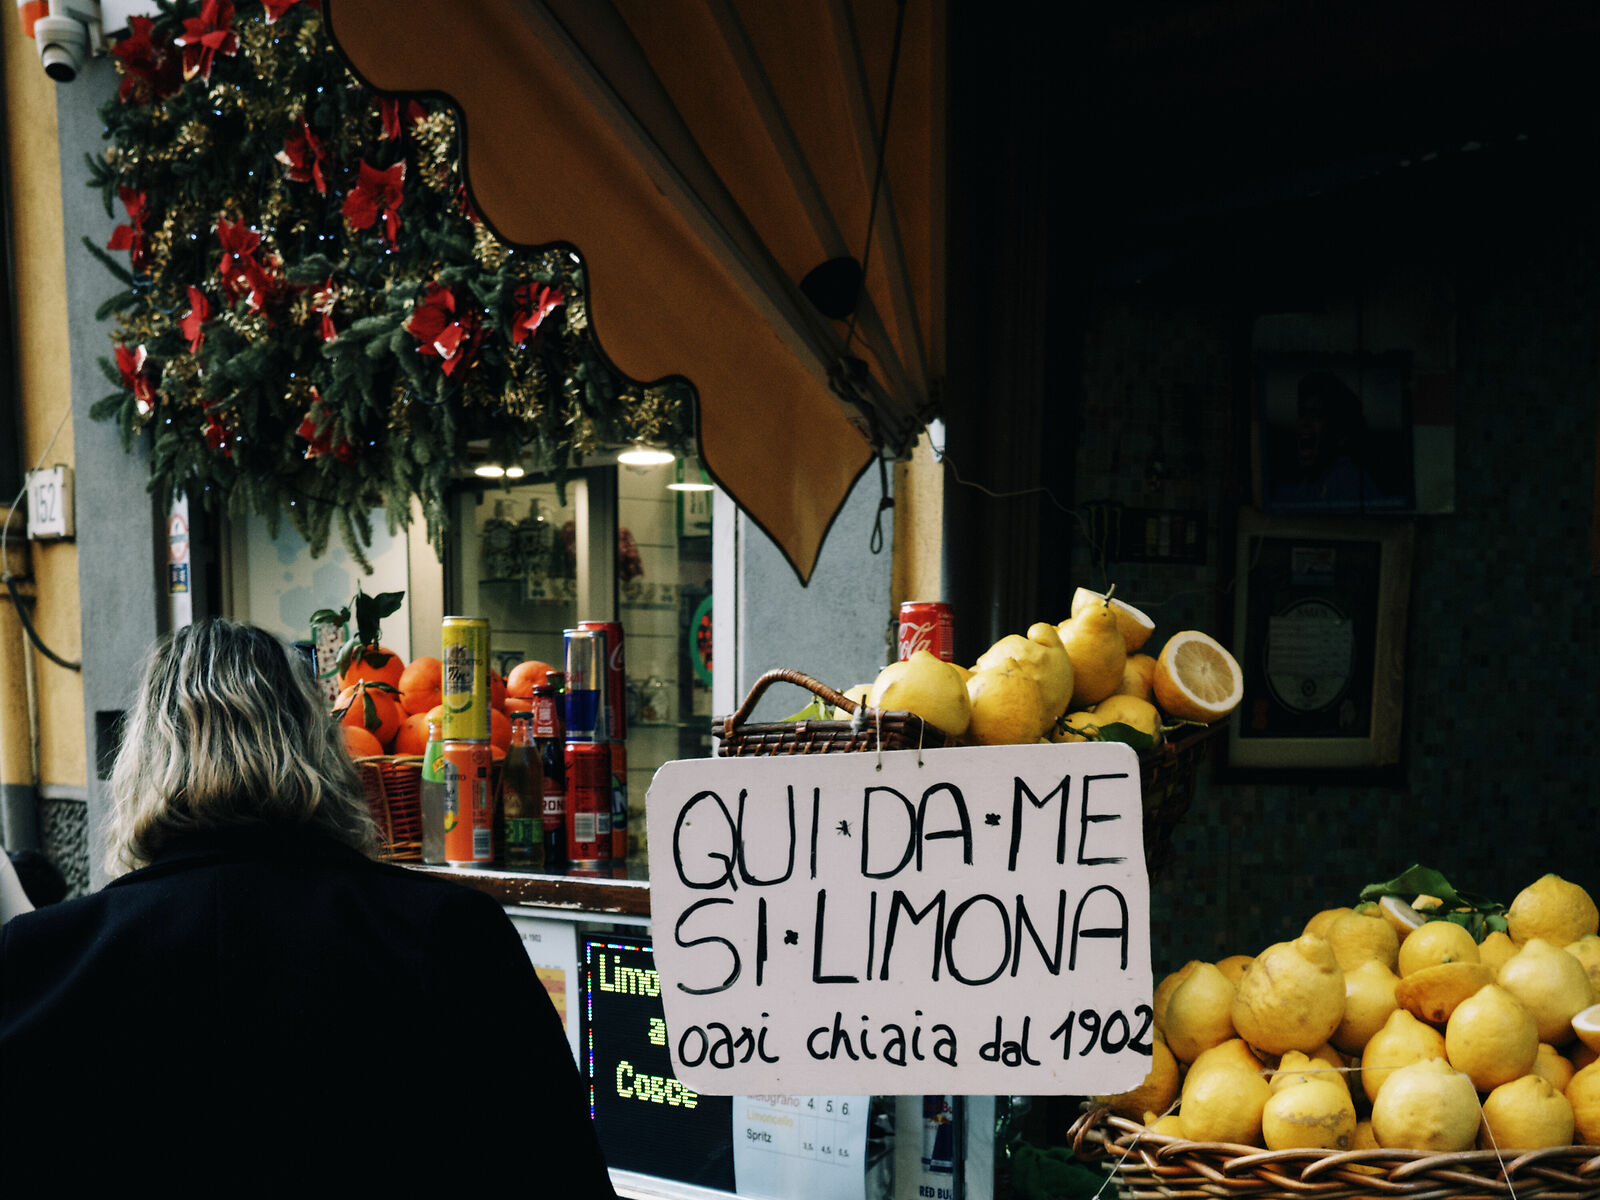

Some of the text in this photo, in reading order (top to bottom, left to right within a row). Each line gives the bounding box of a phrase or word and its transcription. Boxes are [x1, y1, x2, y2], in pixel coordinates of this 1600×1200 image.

[36, 483, 56, 523] 152
[678, 1004, 1154, 1068] oasi chiaia dal 1902
[747, 1128, 772, 1143] Spritz
[919, 1185, 935, 1198] RED
